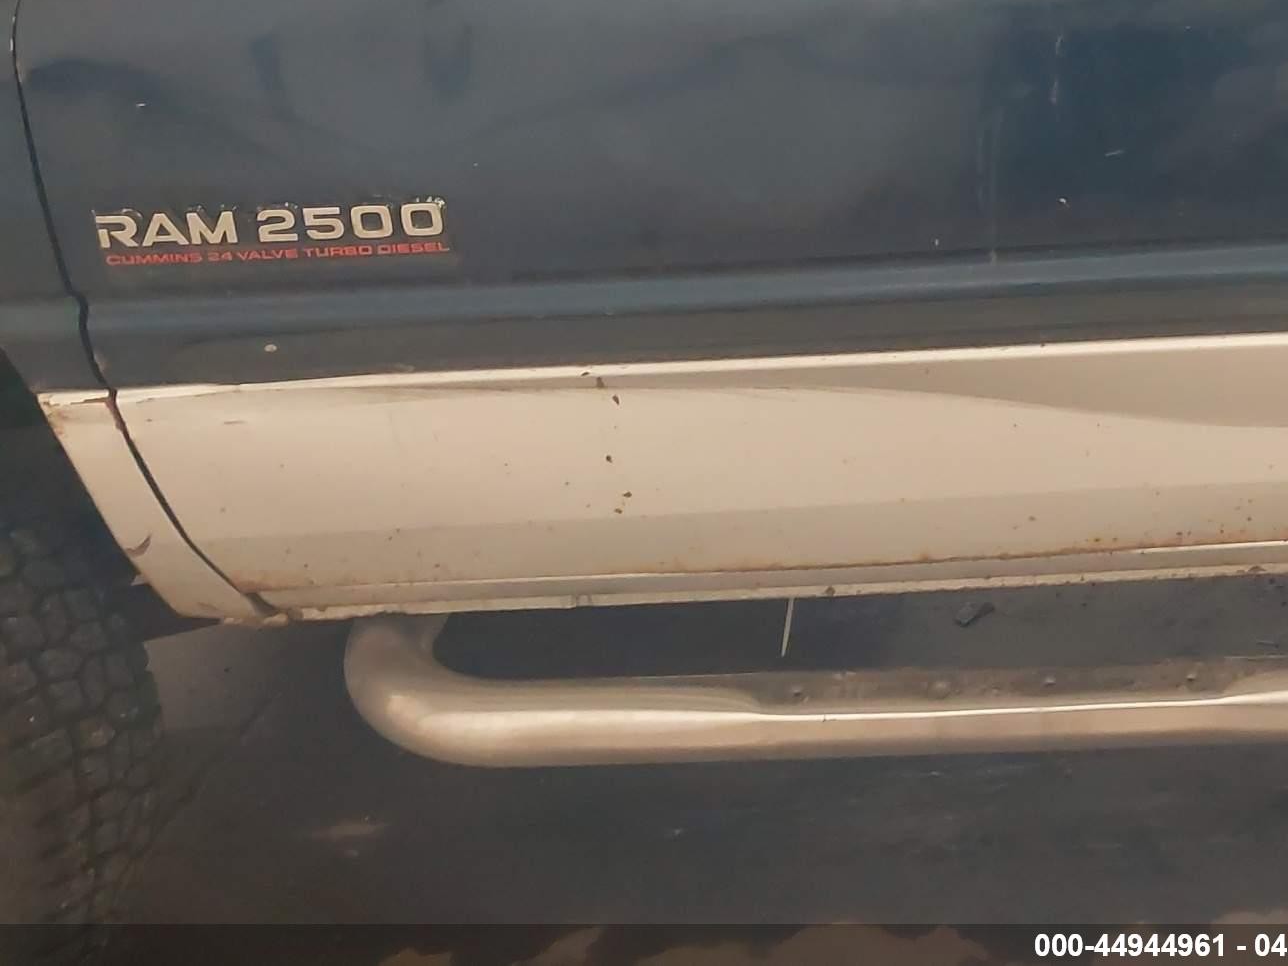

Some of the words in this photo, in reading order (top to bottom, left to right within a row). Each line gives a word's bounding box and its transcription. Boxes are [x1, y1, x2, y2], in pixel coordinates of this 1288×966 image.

[95, 210, 239, 248] RAM
[256, 202, 443, 243] 2500
[106, 252, 203, 266] CUMMINS
[208, 251, 233, 262] 24
[237, 247, 299, 262] VALVE
[304, 245, 372, 258] TURBO
[377, 242, 450, 254] DIESEL
